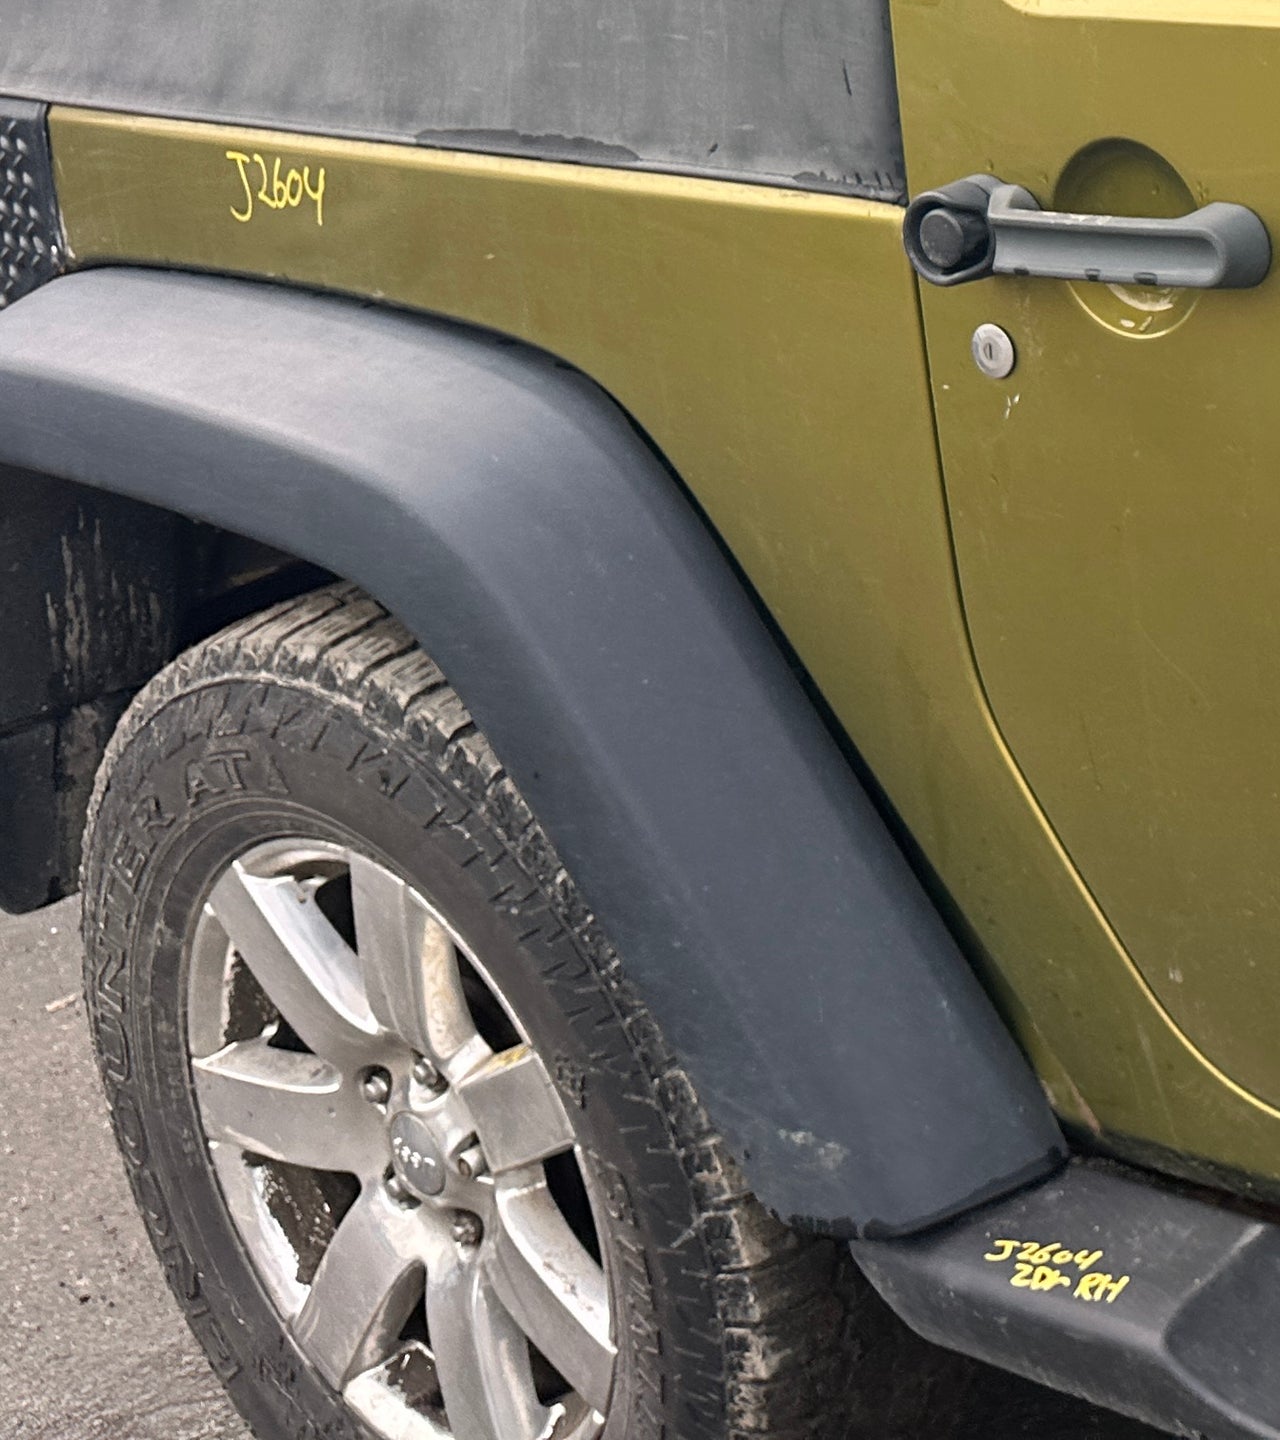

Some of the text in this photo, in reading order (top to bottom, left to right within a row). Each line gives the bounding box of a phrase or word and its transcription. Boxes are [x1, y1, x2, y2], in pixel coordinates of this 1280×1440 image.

[226, 150, 325, 226] J2604
[984, 1239, 1104, 1271] J2604
[1073, 1272, 1130, 1303] RH
